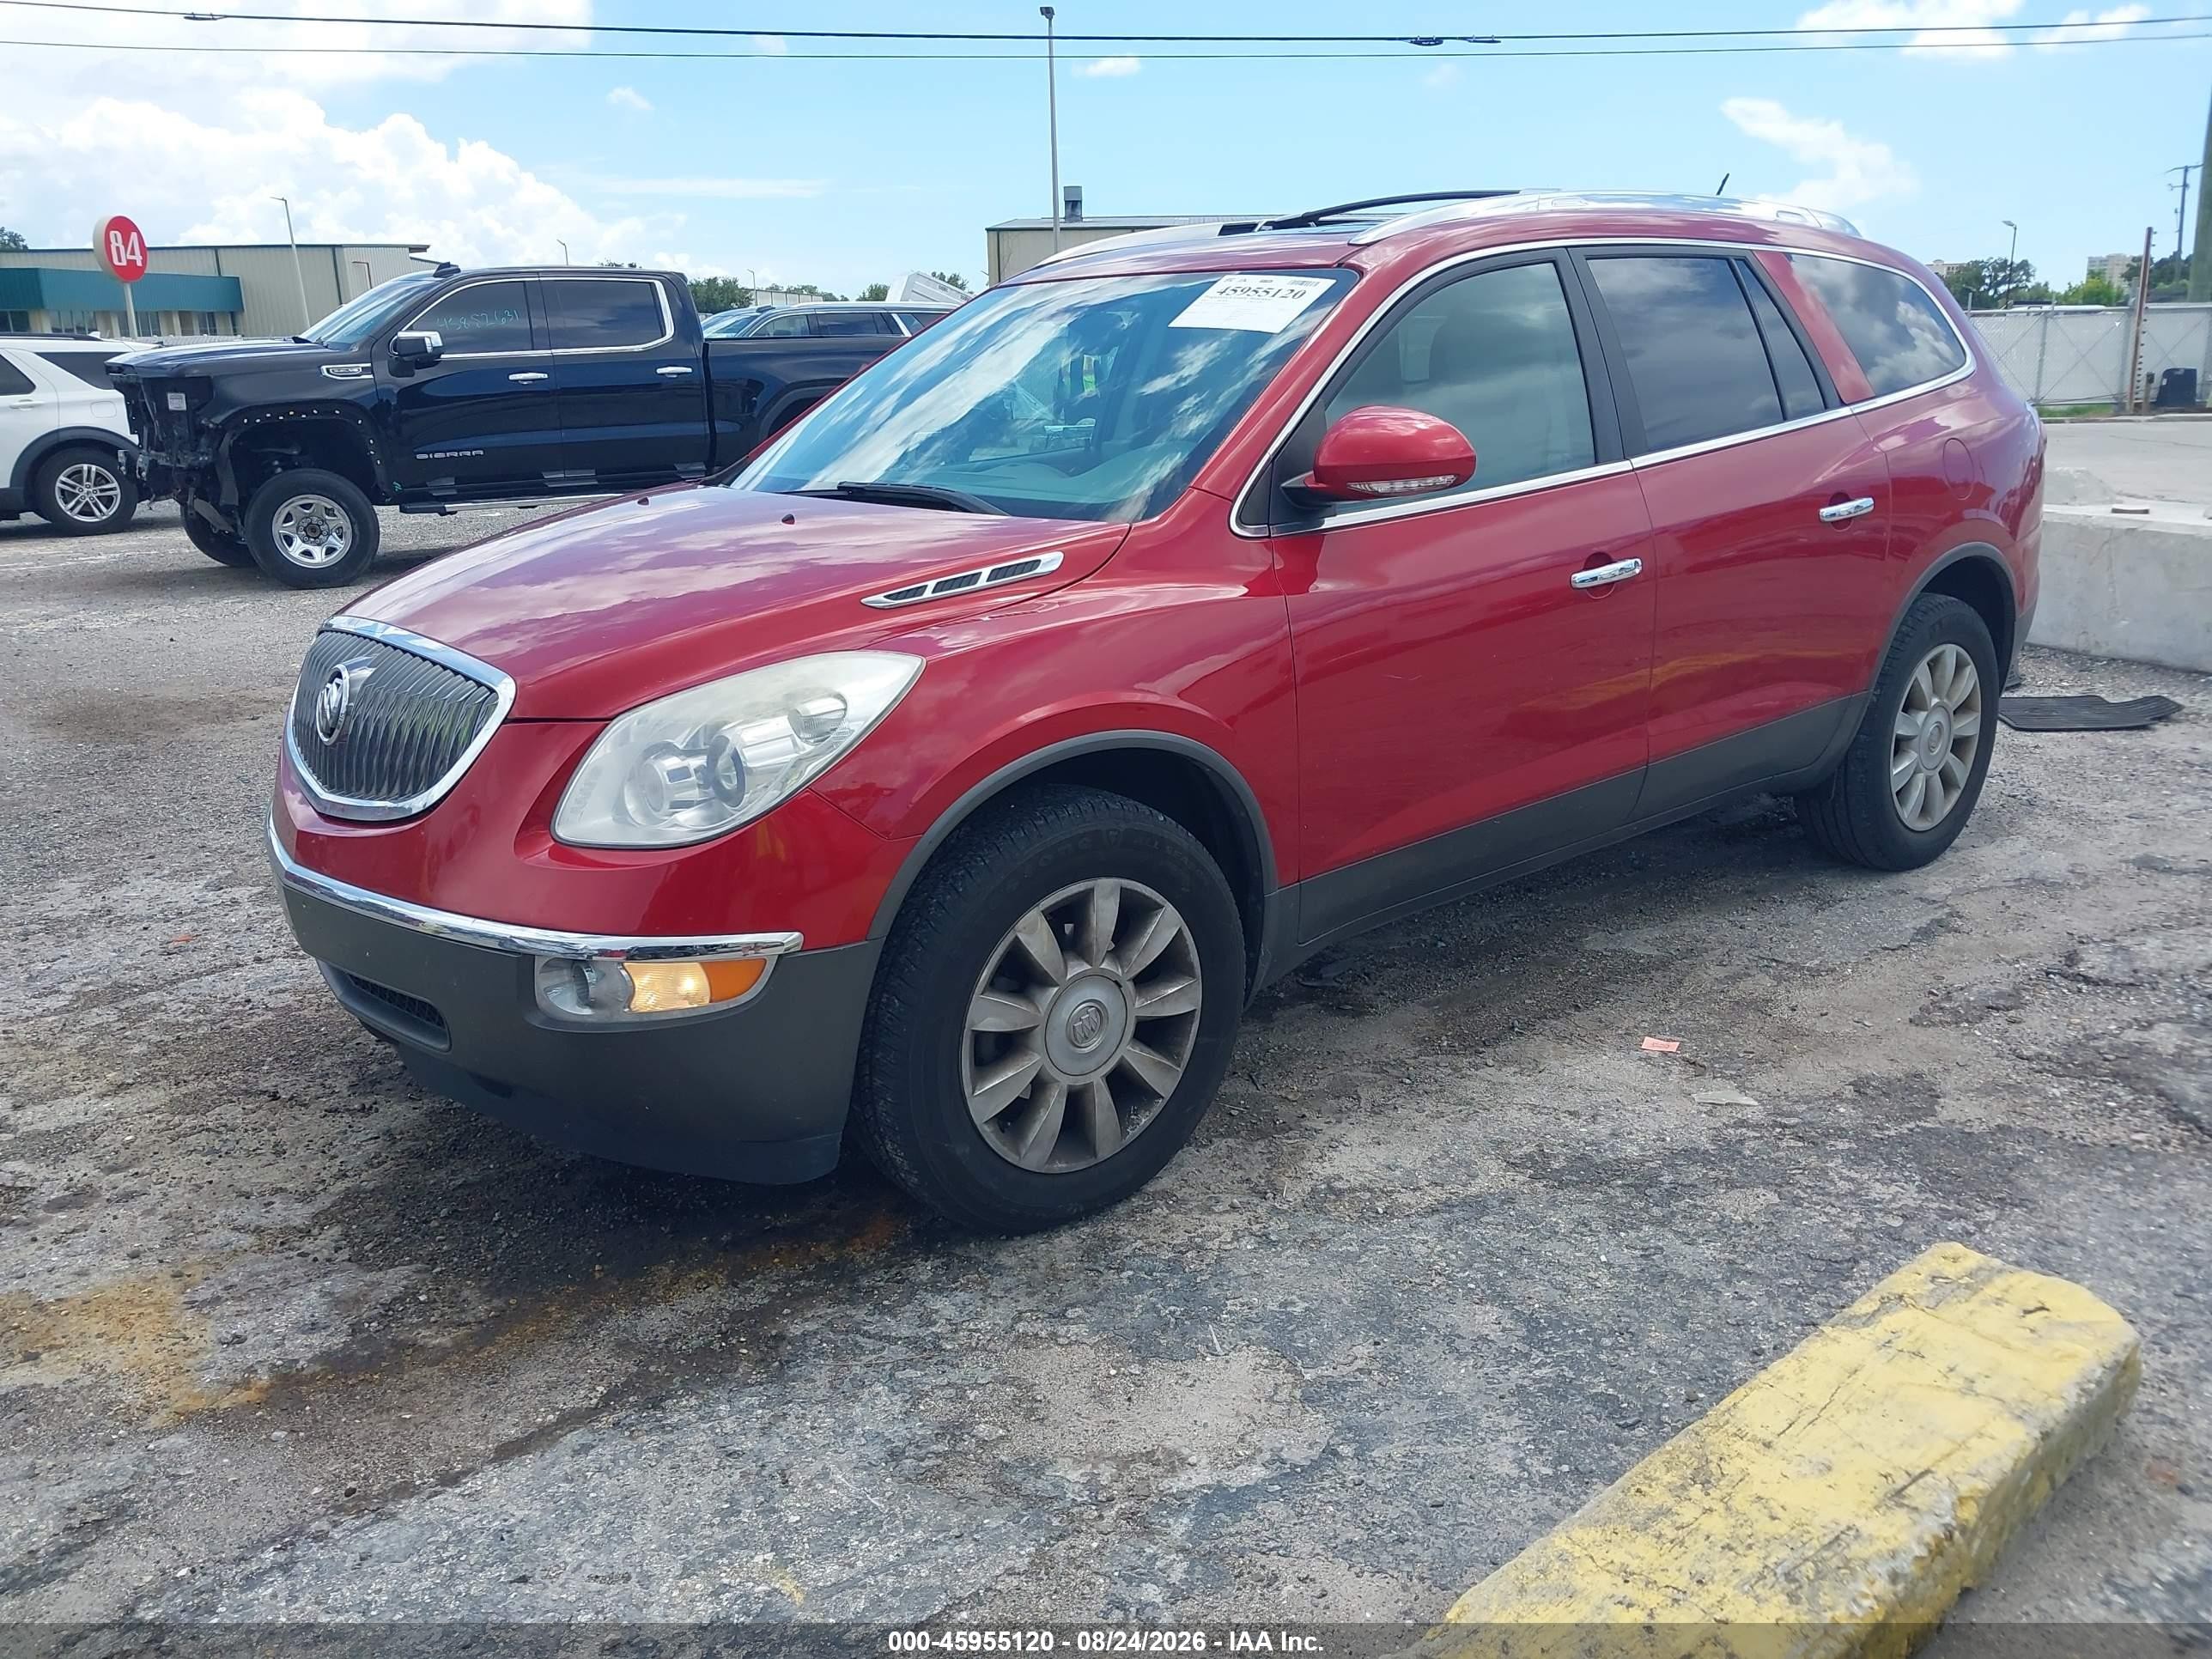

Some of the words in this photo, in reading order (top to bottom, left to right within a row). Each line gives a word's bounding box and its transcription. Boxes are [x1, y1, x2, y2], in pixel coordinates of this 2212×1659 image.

[109, 230, 143, 267] 84
[1216, 285, 1308, 301] 45955120
[416, 449, 485, 460] SIERRA
